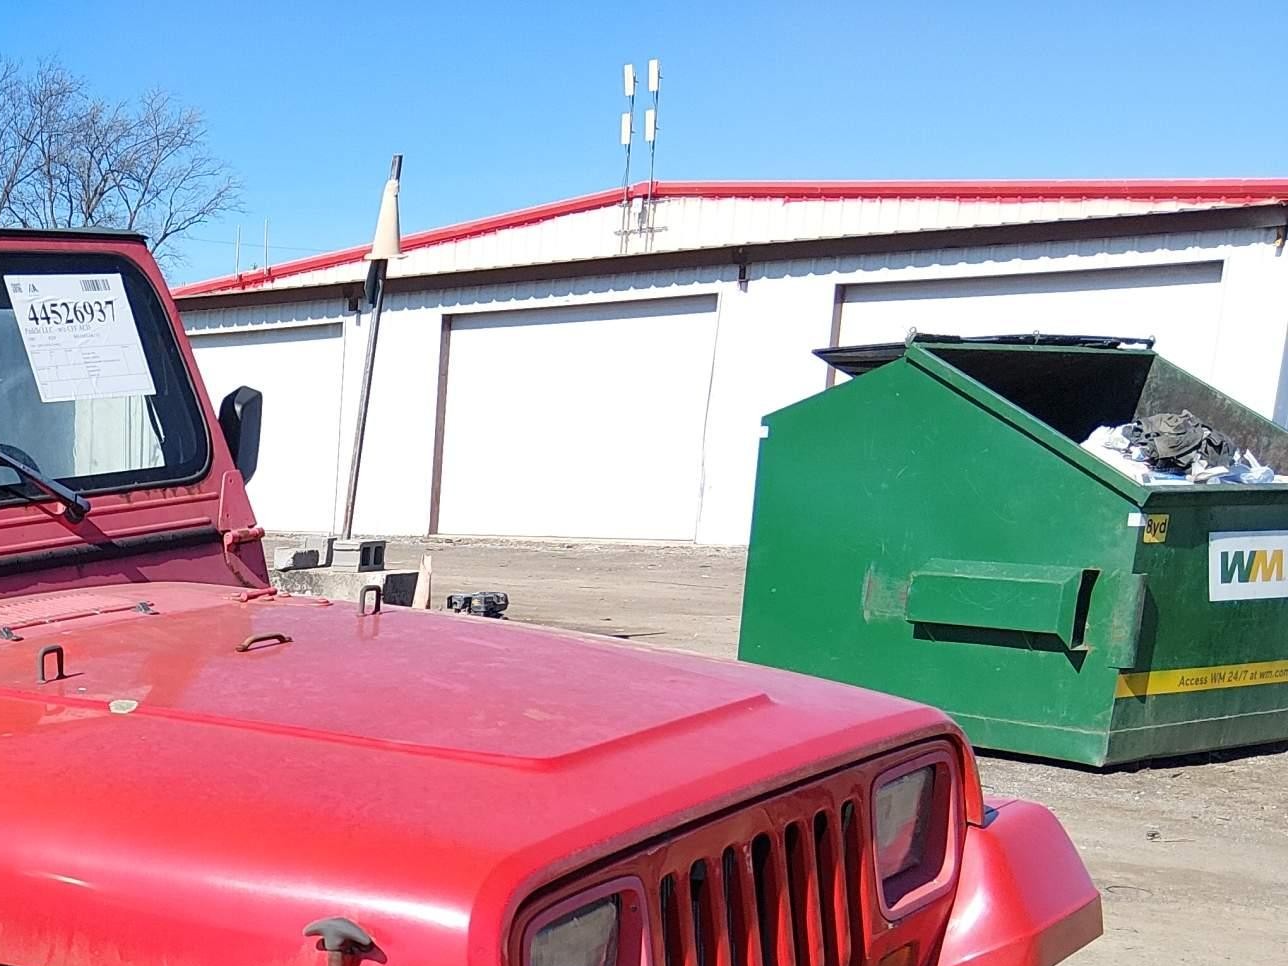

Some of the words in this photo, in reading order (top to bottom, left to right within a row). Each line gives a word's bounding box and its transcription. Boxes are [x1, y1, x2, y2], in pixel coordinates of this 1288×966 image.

[27, 299, 116, 326] 44526937
[1145, 517, 1168, 535] 8yd
[1220, 548, 1284, 585] WM
[1178, 675, 1209, 688] Access
[1210, 671, 1226, 685] WM
[1227, 670, 1249, 683] 24/7
[1249, 672, 1258, 681] at
